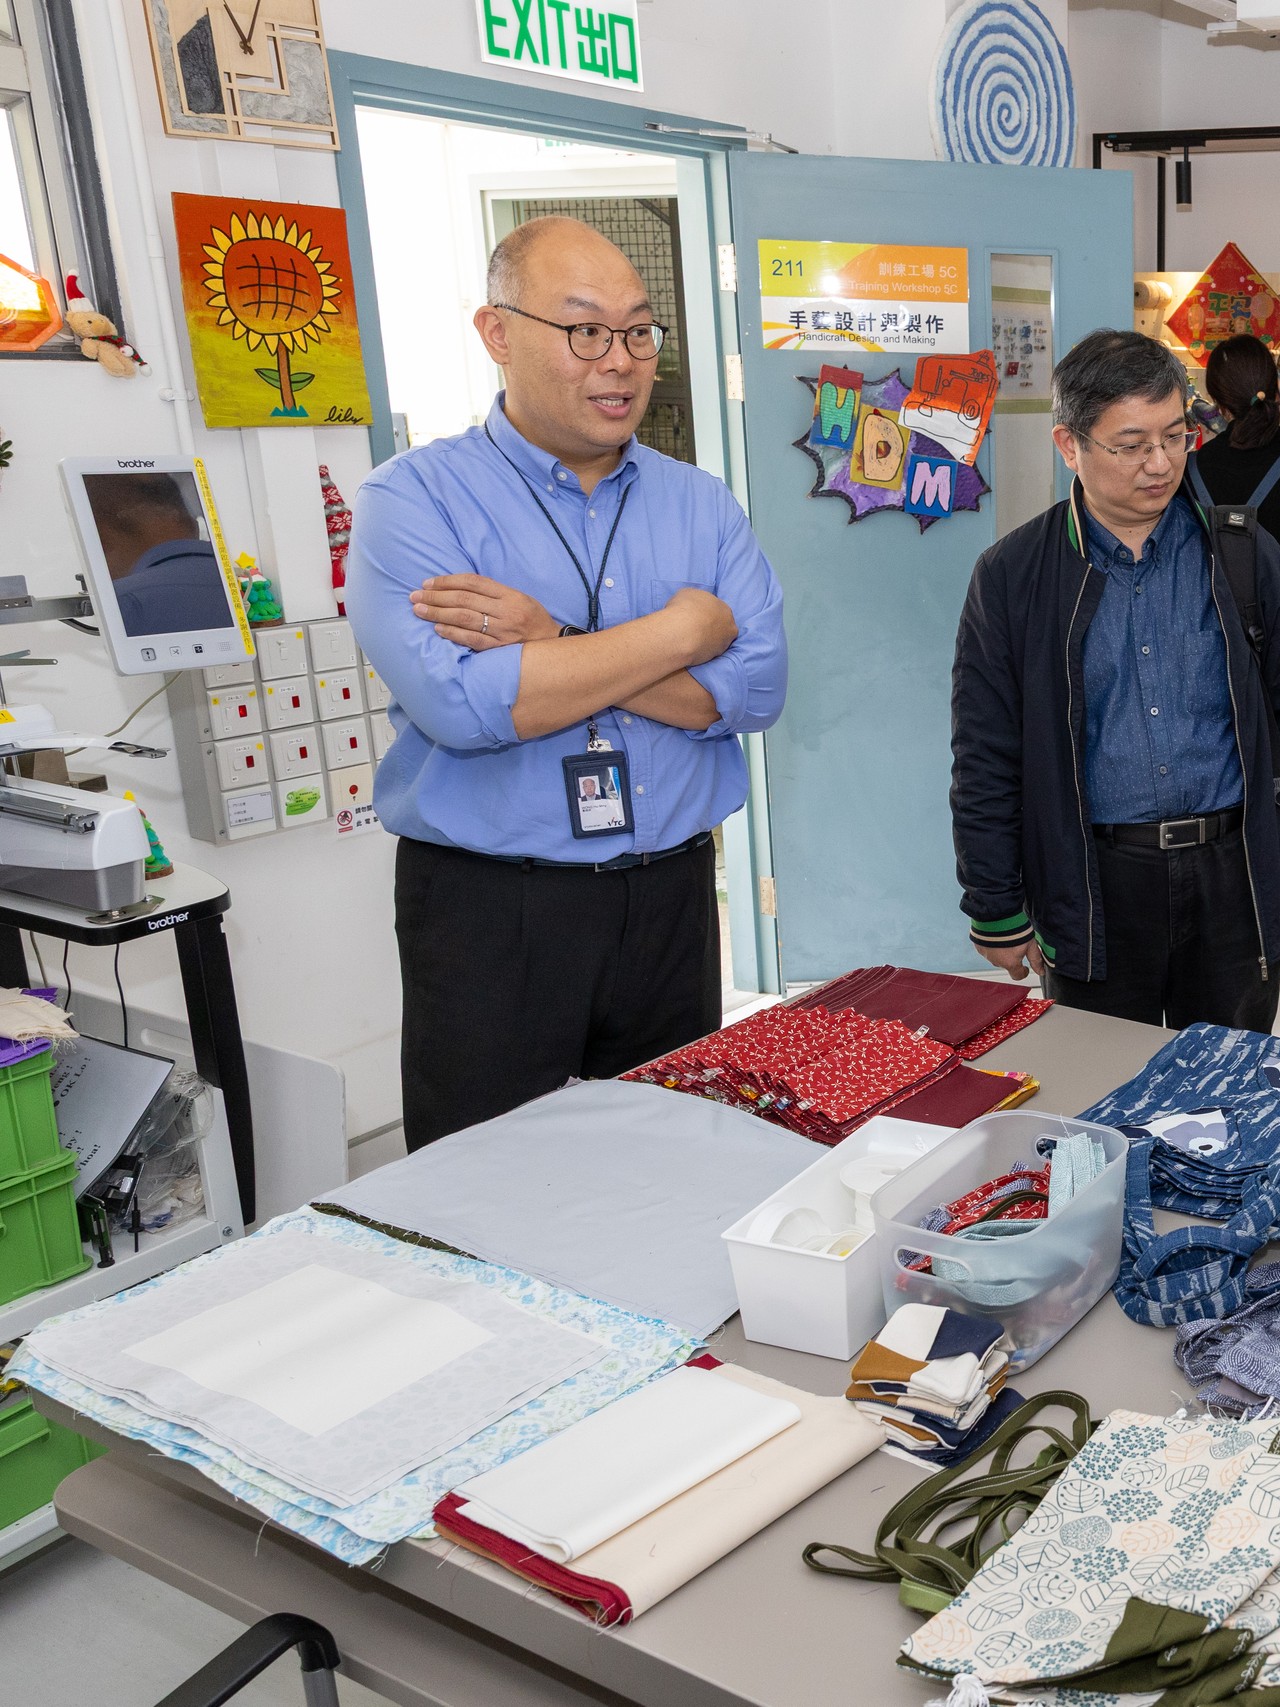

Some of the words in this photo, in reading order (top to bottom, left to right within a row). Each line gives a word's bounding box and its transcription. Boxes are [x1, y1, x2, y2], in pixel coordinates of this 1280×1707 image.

[483, 0, 570, 70] EXIT
[575, 7, 638, 84] 出口
[771, 259, 804, 277] 211
[879, 262, 935, 278] 訓練工場
[939, 266, 957, 279] 5C
[849, 280, 889, 293] Training
[892, 283, 941, 295] Workshop
[944, 284, 958, 295] 5C
[1208, 291, 1252, 319] 平安
[788, 310, 945, 334] 手藝設計與製作
[798, 332, 846, 342] Handicraft
[849, 332, 880, 345] Design
[883, 335, 900, 344] and
[903, 335, 936, 346] Making
[324, 405, 364, 424] lily
[117, 459, 155, 468] brother
[147, 911, 189, 930] brother
[60, 1080, 76, 1097] OK
